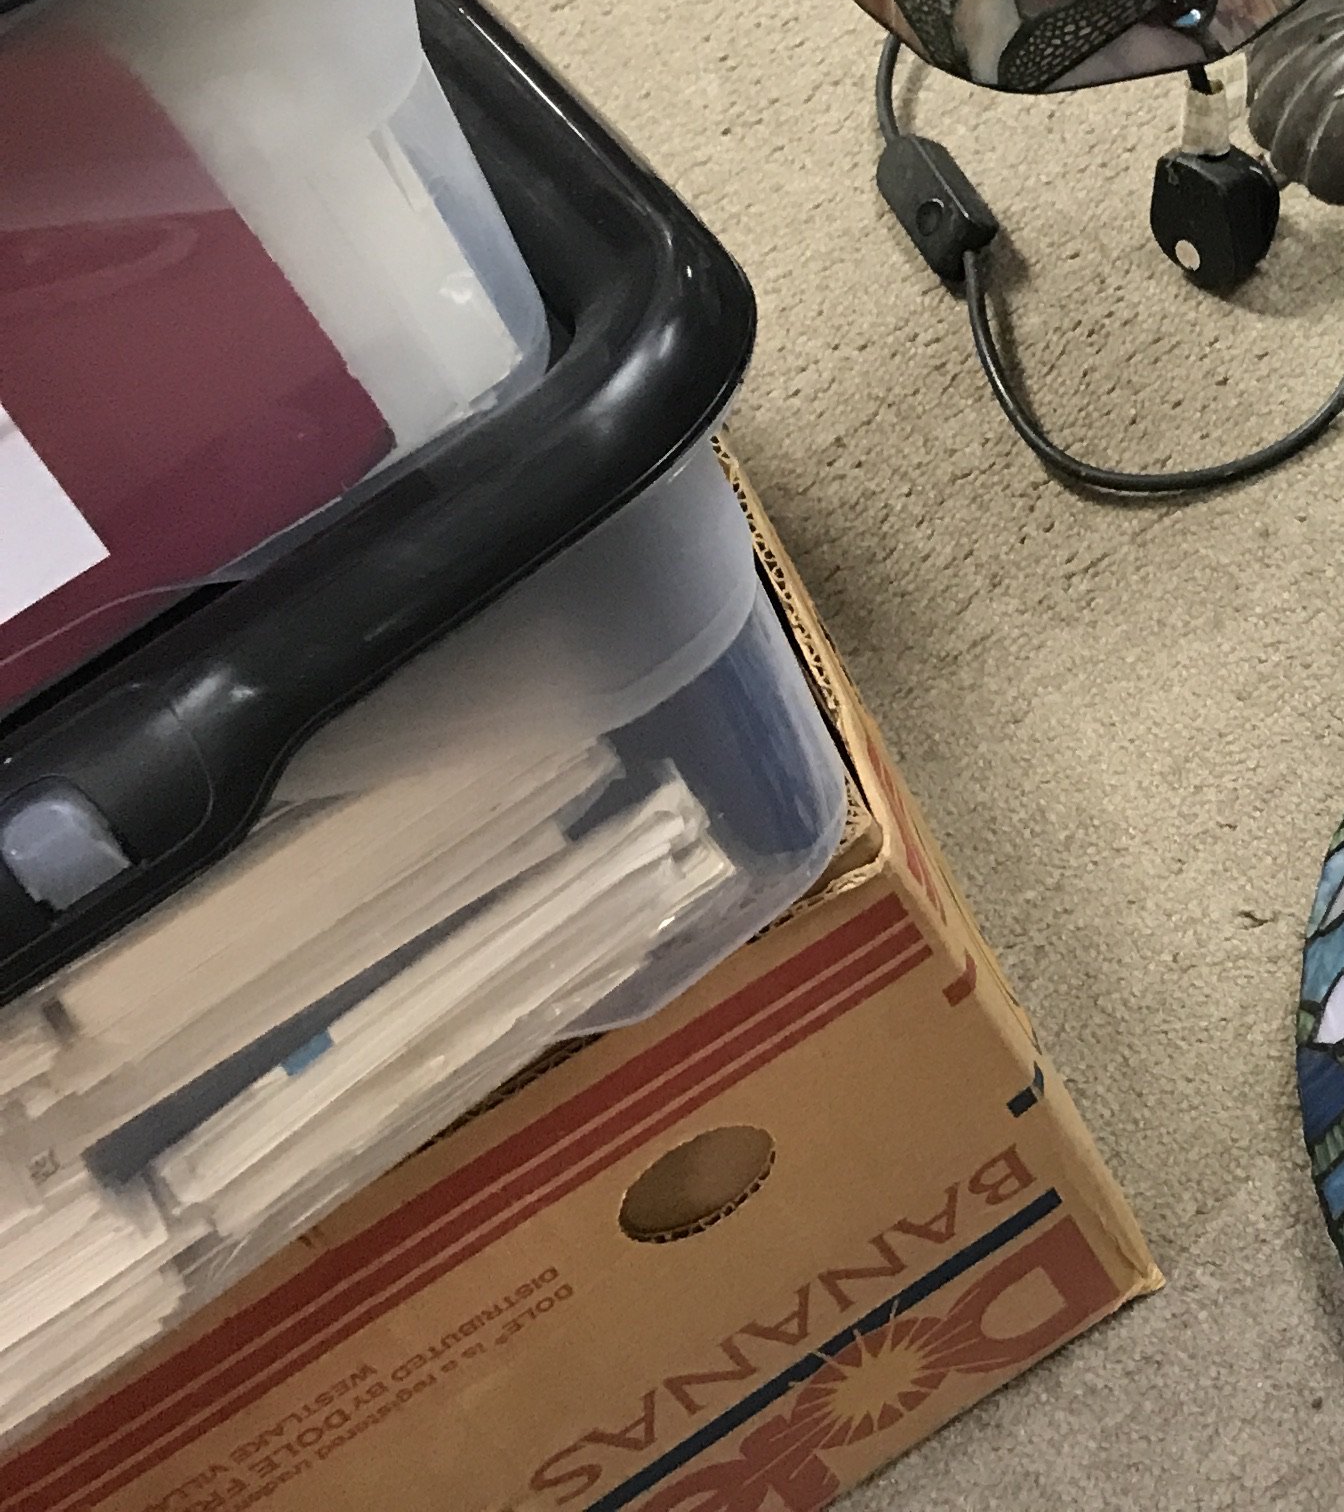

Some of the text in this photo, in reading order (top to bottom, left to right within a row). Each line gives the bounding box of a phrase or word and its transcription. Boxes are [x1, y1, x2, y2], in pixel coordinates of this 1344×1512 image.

[391, 1266, 558, 1382] DISTRIBUTED
[529, 1144, 1037, 1505] BANANAS
[230, 1364, 377, 1465] WESTLAKE
[315, 1374, 437, 1460] registered
[352, 1381, 389, 1411] BY
[248, 1408, 350, 1479] DOLE
